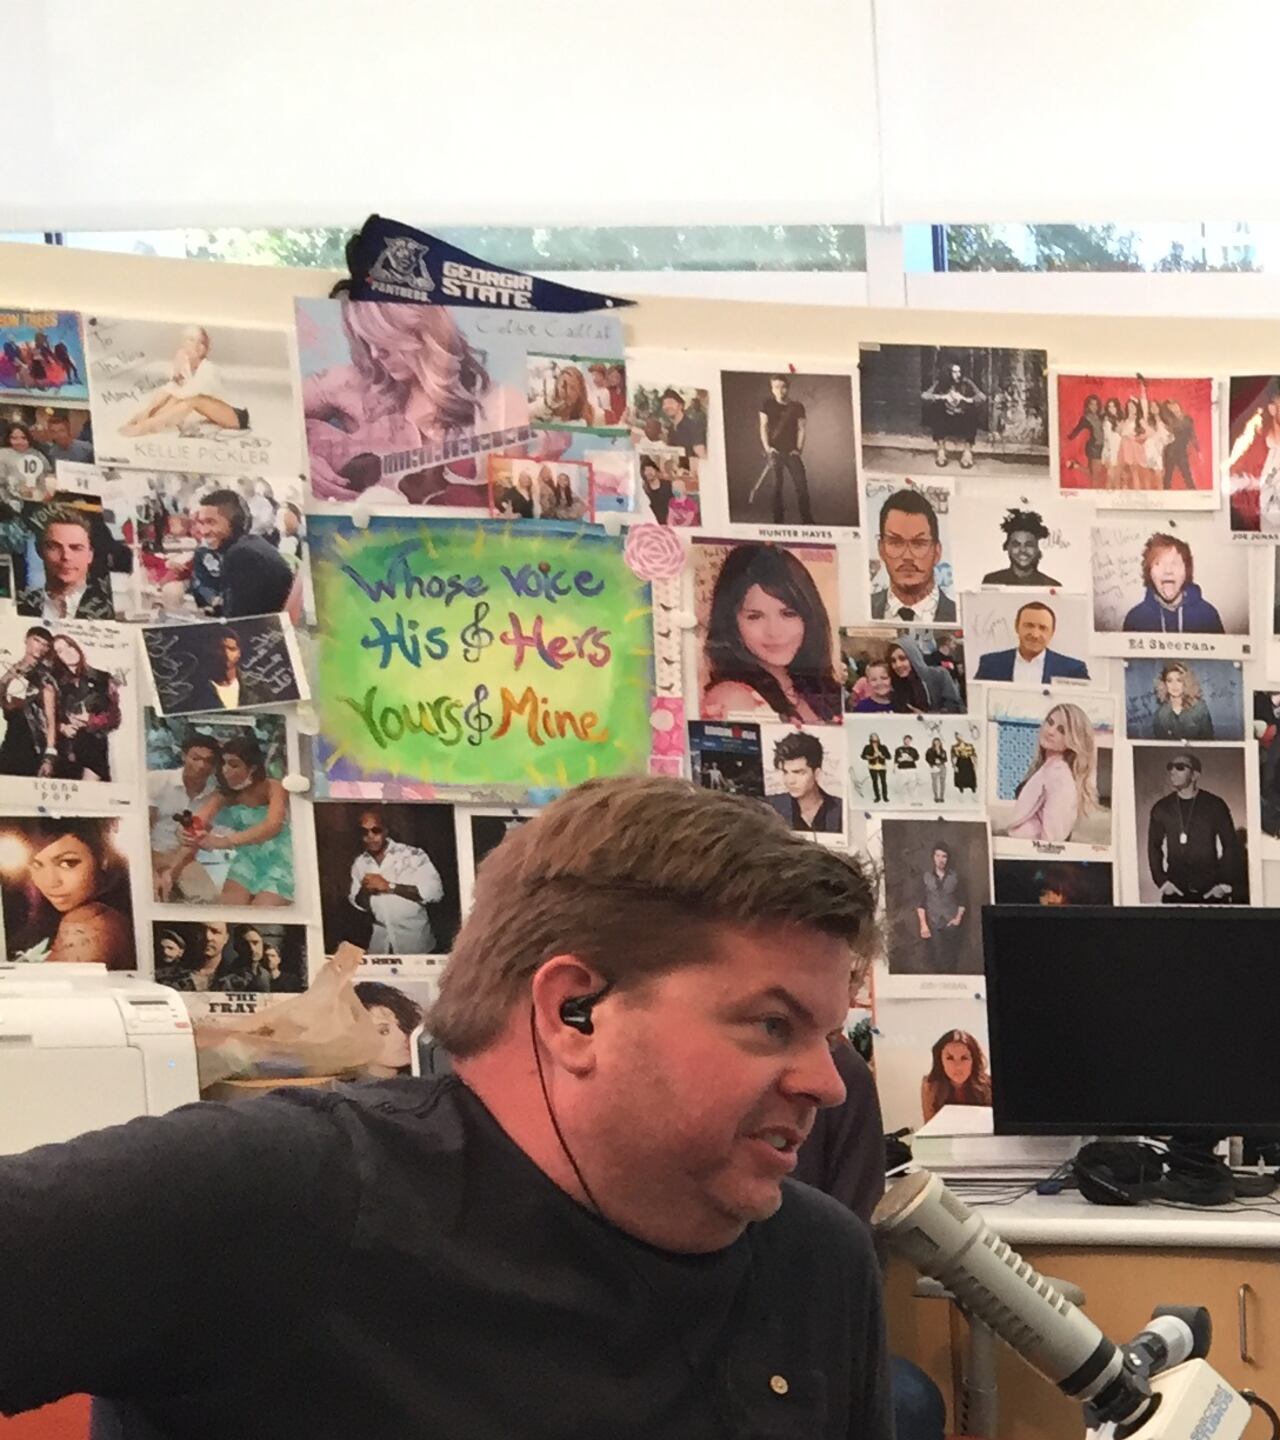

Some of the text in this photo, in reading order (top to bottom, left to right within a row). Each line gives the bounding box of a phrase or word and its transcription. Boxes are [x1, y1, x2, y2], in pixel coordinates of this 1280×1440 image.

[442, 261, 534, 291] GEORGIA
[441, 278, 534, 309] STATE
[134, 442, 271, 466] KELLIE PICKLER
[23, 458, 38, 475] 10
[758, 528, 834, 540] HUNTER HAYES
[340, 538, 490, 608] Whose
[360, 612, 450, 670] His
[500, 611, 613, 671] Hers
[1128, 638, 1146, 650] Ed
[336, 685, 609, 750] Yours Mine
[208, 1002, 258, 1014] FRAY
[225, 992, 258, 1002] THE
